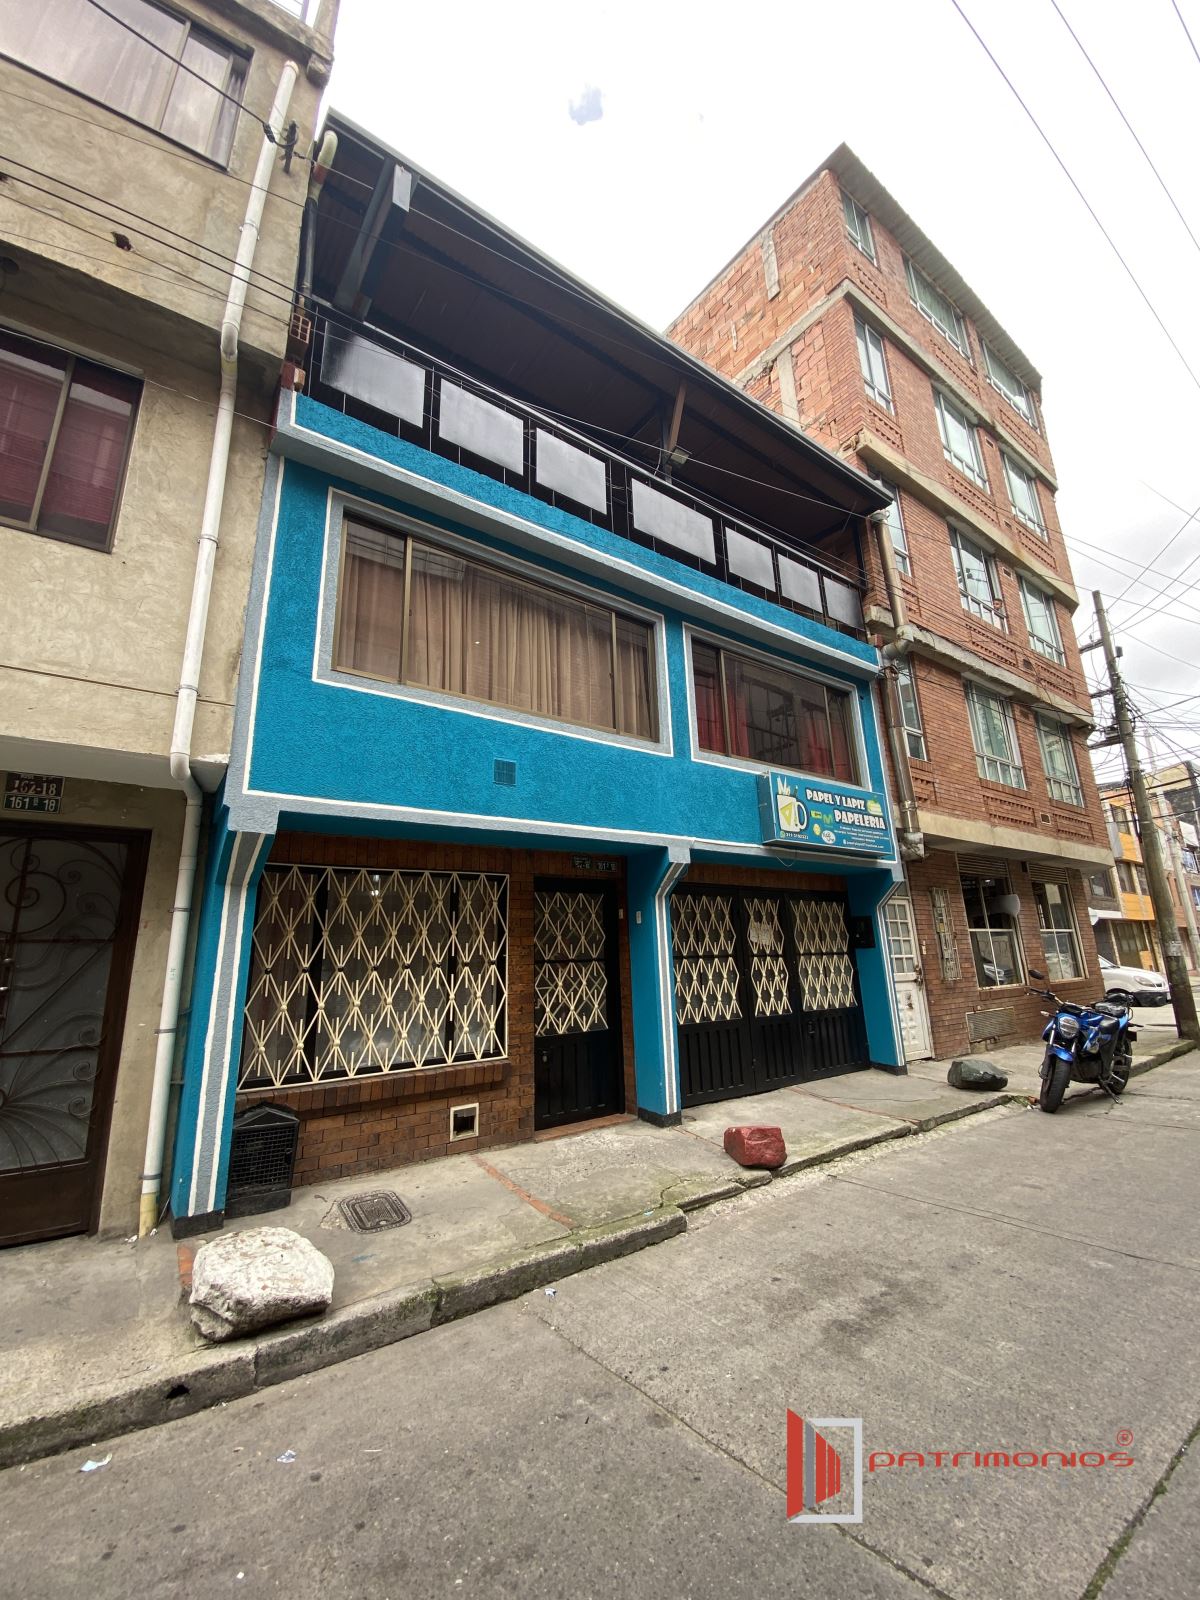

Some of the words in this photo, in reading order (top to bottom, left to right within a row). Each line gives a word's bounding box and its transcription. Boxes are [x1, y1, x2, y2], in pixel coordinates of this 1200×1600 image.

[9, 796, 30, 809] 161
[43, 799, 56, 812] 18
[806, 789, 834, 804] PAPEL
[835, 795, 841, 806] Y
[842, 796, 866, 810] LAPIZ
[834, 810, 886, 830] PAPELERIA
